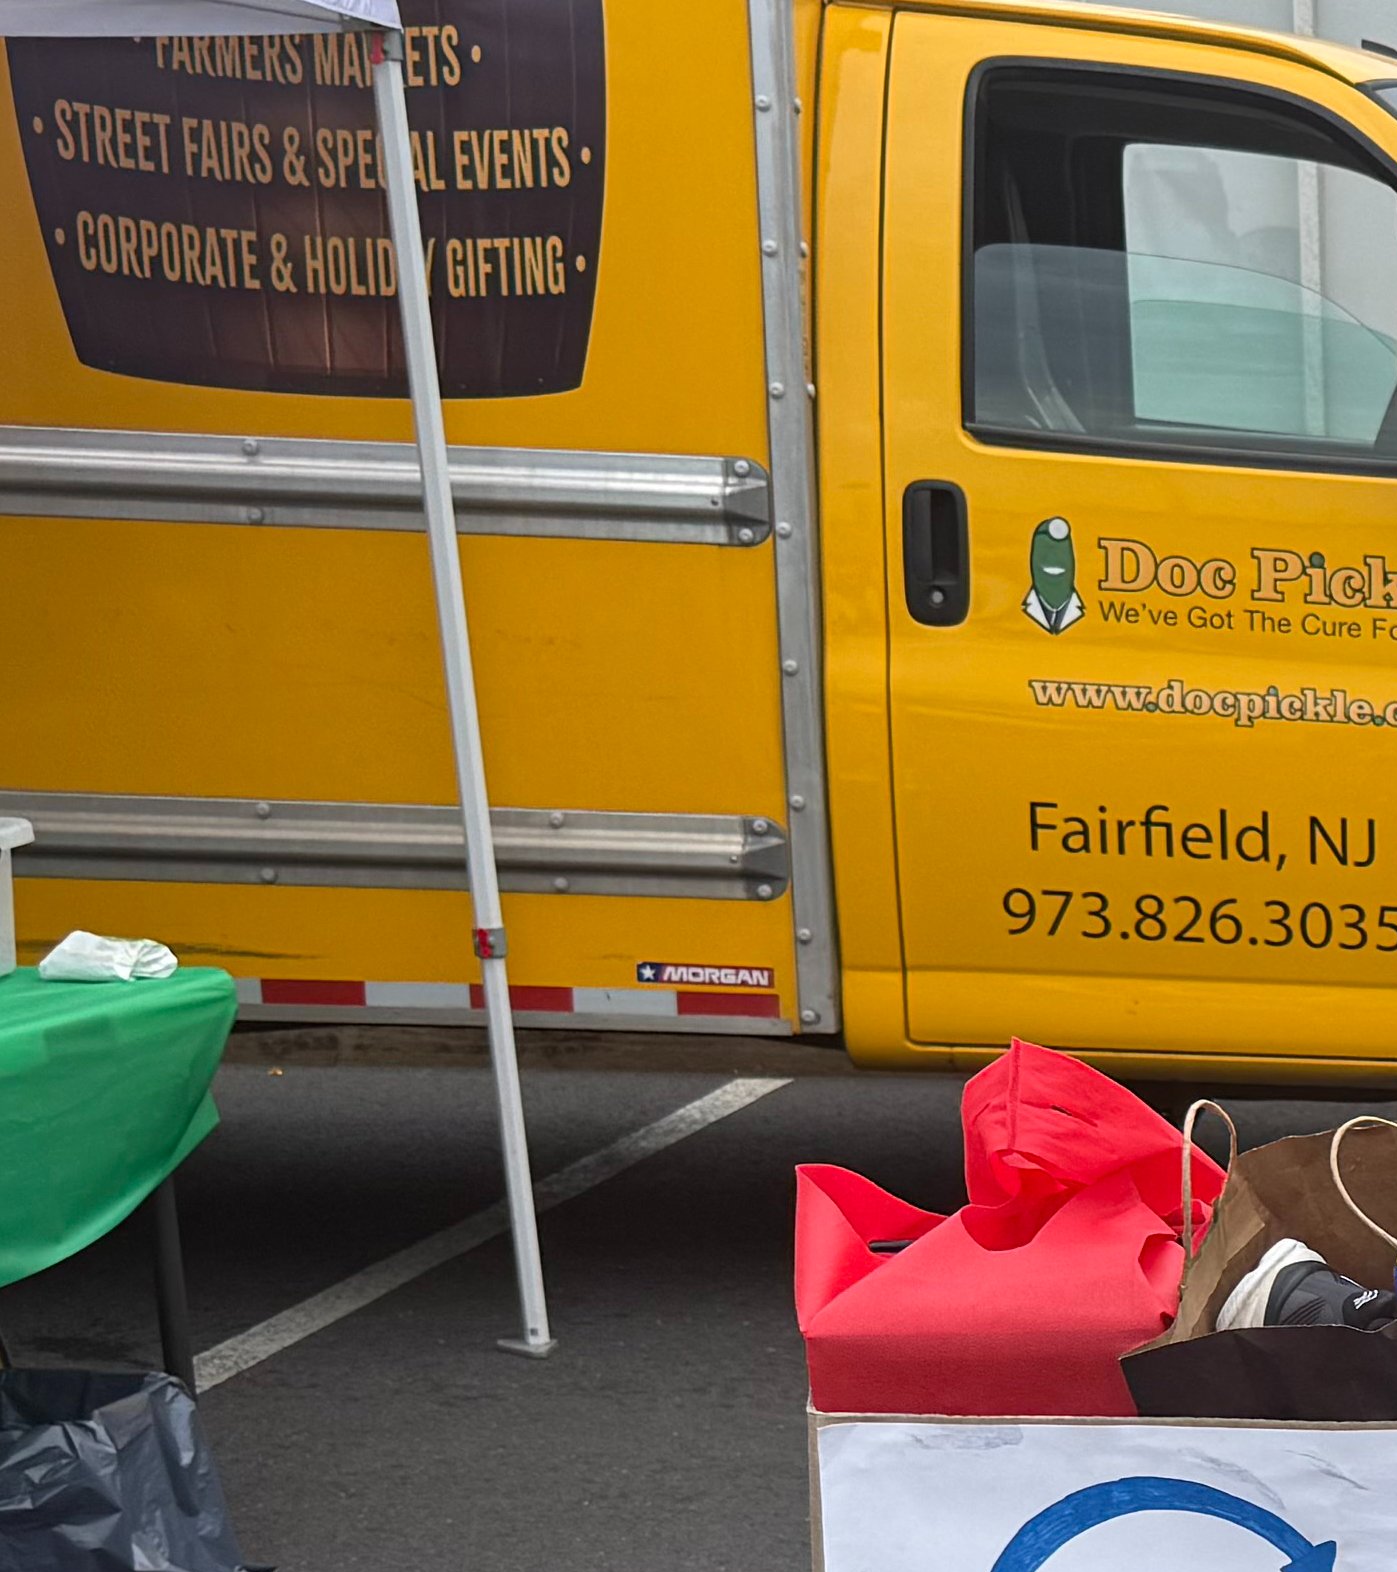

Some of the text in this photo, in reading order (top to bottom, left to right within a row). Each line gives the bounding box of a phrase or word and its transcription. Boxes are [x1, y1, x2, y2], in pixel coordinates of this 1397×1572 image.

[155, 25, 462, 88] FARMERS MAETS
[55, 98, 170, 175] STREET
[182, 116, 273, 185] FAIRS
[283, 126, 310, 188] &
[453, 127, 571, 191] EVENTS
[76, 210, 566, 298] CORPORATE & HOLIDY GIFTING
[1098, 537, 1236, 594] Doc
[1099, 600, 1178, 628] We've
[1187, 606, 1235, 631] Got
[1243, 608, 1292, 635] The
[1301, 612, 1362, 640] Cure
[1029, 801, 1379, 872] Fairfield, NJ
[663, 965, 770, 986] MORGAN
